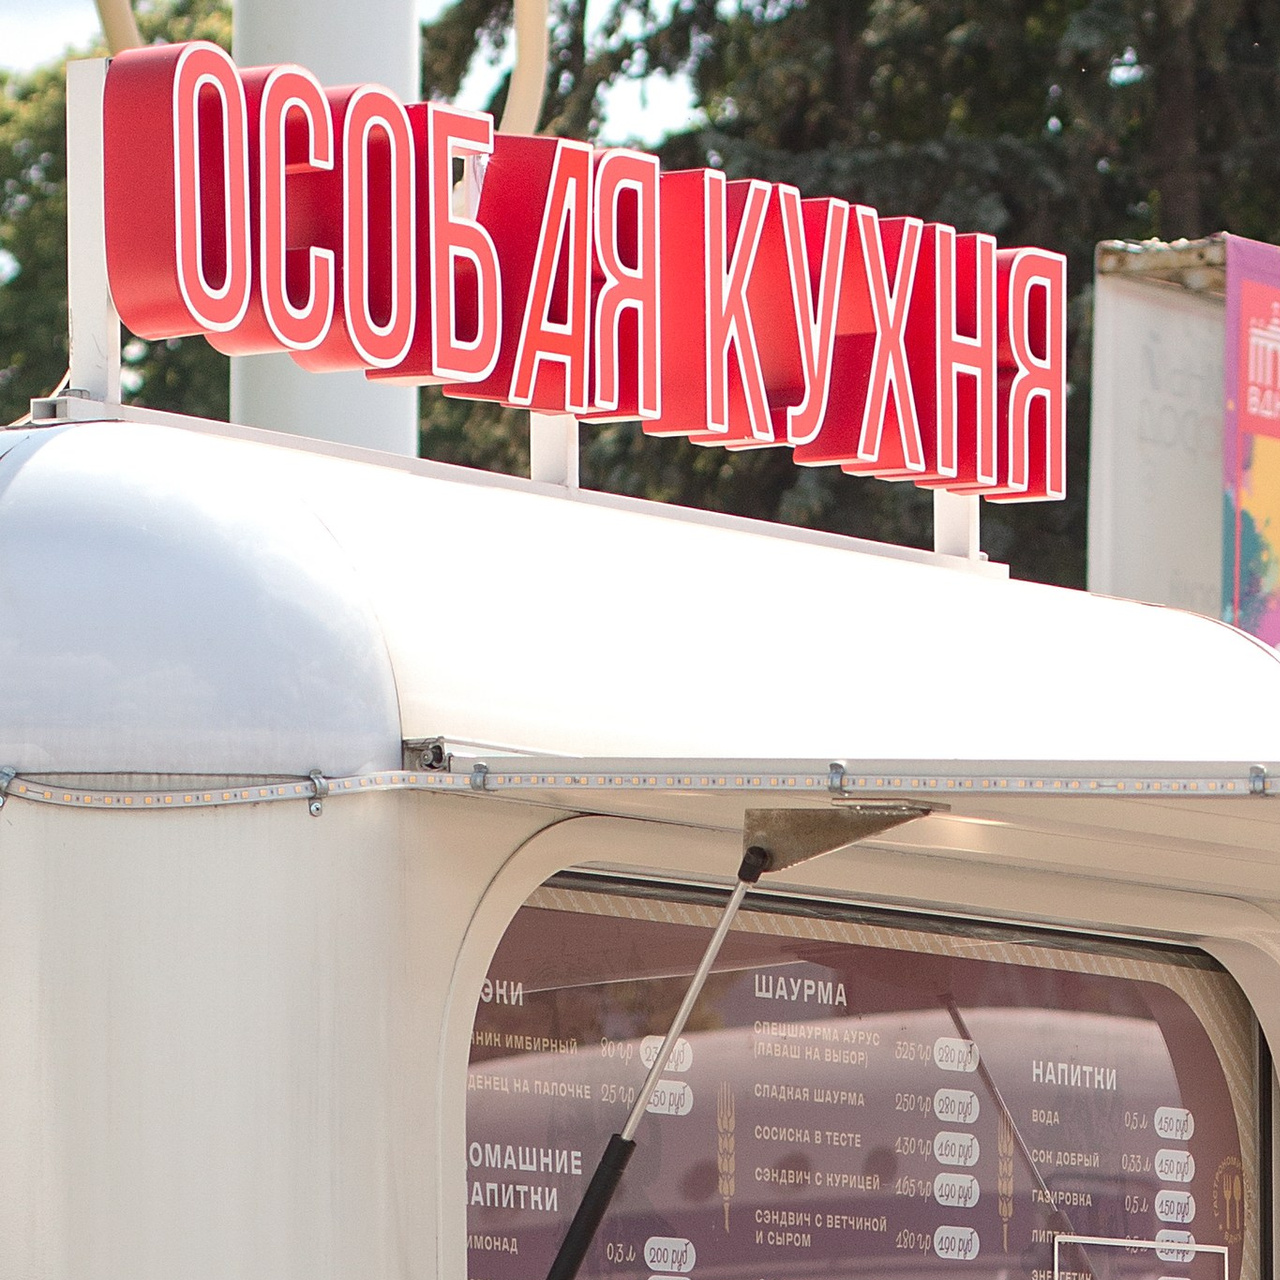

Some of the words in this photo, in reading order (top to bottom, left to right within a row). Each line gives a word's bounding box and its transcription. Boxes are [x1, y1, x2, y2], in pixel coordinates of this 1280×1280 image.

[176, 40, 663, 420] ОСОБАЯ
[703, 168, 1067, 501] КУХНЯ
[755, 974, 847, 1006] ШАУРМА
[506, 1034, 577, 1054] ИМБИРНЫЙ
[601, 1037, 615, 1057] 80
[754, 1021, 839, 1042] СПЕЦШАУРМА
[843, 1030, 880, 1046] АУРУС
[645, 1046, 658, 1062] 23
[754, 1041, 800, 1059] (ЛАВАШ
[805, 1047, 820, 1060] НА
[825, 1049, 868, 1069] ВЫБОР)
[895, 1041, 916, 1060] 325
[939, 1045, 955, 1063] 280
[1033, 1060, 1116, 1090] НАПИТКИ
[514, 1079, 530, 1093] НА
[535, 1081, 591, 1099] ПАЛОЧКЕ
[601, 1084, 616, 1103] 25
[648, 1090, 666, 1107] 50
[754, 1084, 809, 1101] СЛАДКАЯ
[814, 1089, 865, 1106] ШАУРМА
[895, 1093, 916, 1112] 250
[939, 1096, 955, 1114] 280
[1032, 1109, 1060, 1126] ВОДА
[1158, 1116, 1173, 1132] 150
[754, 1125, 810, 1143] СОСИСКА
[815, 1130, 822, 1144] В
[826, 1132, 861, 1147] ТЕСТЕ
[895, 1136, 916, 1156] 130
[938, 1140, 956, 1157] 160
[467, 1142, 582, 1175] ОМАШНИЕ
[1032, 1149, 1052, 1164] СОК
[1056, 1152, 1099, 1168] ДОБРЫЙ
[1158, 1159, 1174, 1175] 150
[755, 1167, 811, 1185] СЭНДВИЧ
[815, 1172, 822, 1186] С
[826, 1173, 880, 1191] КУРИЦЕЙ
[895, 1176, 916, 1197] 165
[939, 1184, 956, 1200] 190
[467, 1182, 558, 1212] АПИТКИ
[1032, 1189, 1092, 1207] ГАЗИРОВКА
[1159, 1200, 1175, 1216] 150
[755, 1209, 811, 1227] СЭНДВИЧ
[815, 1214, 822, 1227] С
[826, 1215, 887, 1232] ВЕТЧИНОЙ
[755, 1230, 763, 1244] И
[768, 1231, 811, 1247] СЫРОМ
[896, 1229, 915, 1249] 180
[939, 1236, 956, 1253] 190
[650, 1247, 668, 1263] 200
